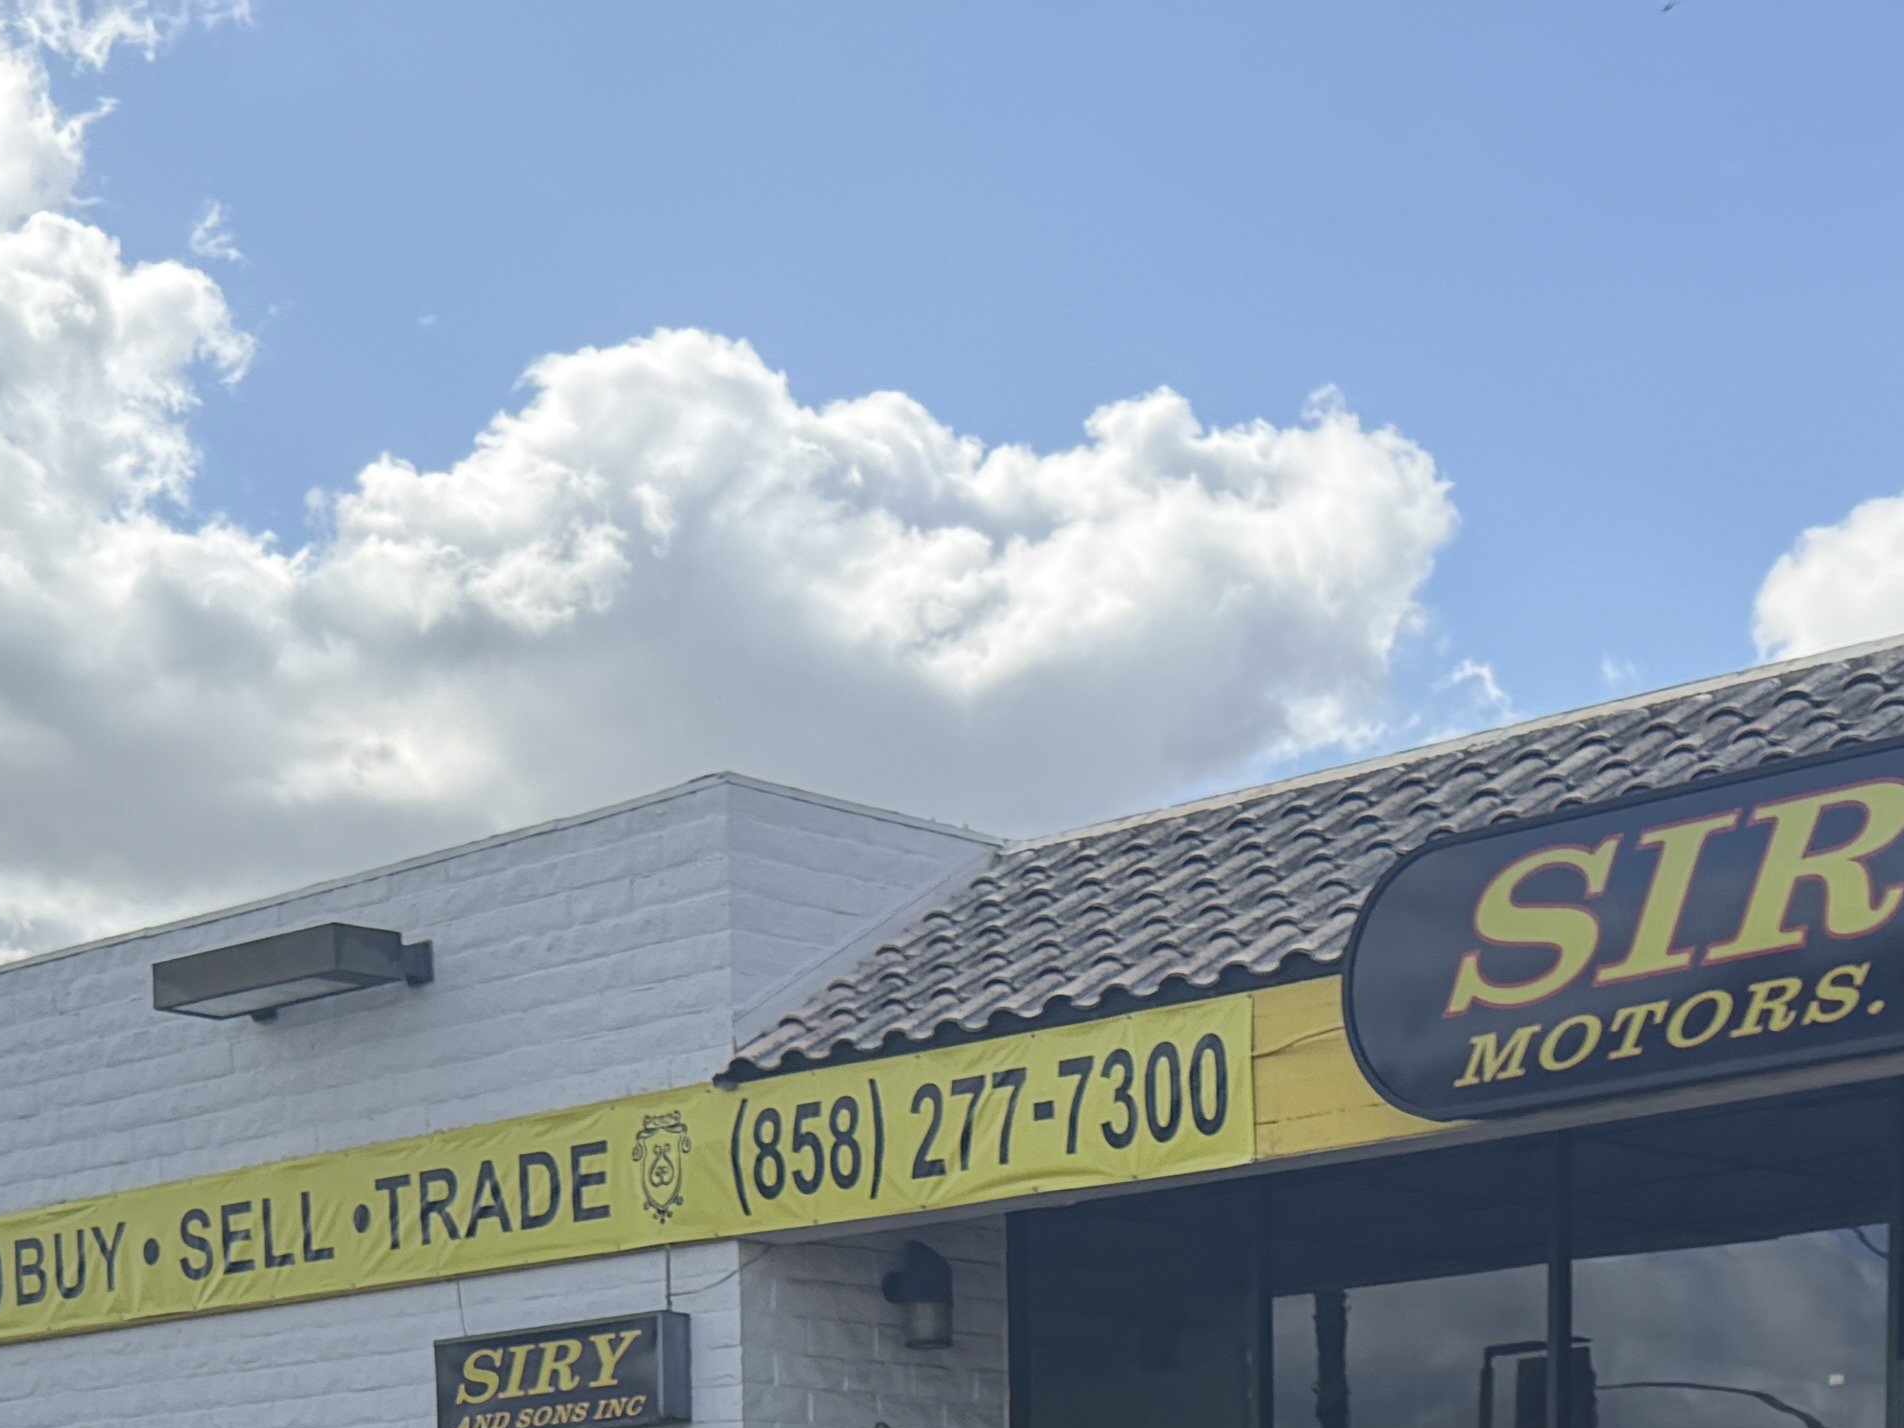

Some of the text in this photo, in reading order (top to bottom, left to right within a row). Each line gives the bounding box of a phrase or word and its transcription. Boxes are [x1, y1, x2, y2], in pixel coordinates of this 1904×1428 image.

[731, 1032, 1228, 1216] (858) 277-7300
[14, 1140, 610, 1306] BUY SELL TRADE
[455, 1330, 642, 1405] SIRY
[516, 1402, 590, 1428] SONS
[593, 1395, 647, 1420] INC
